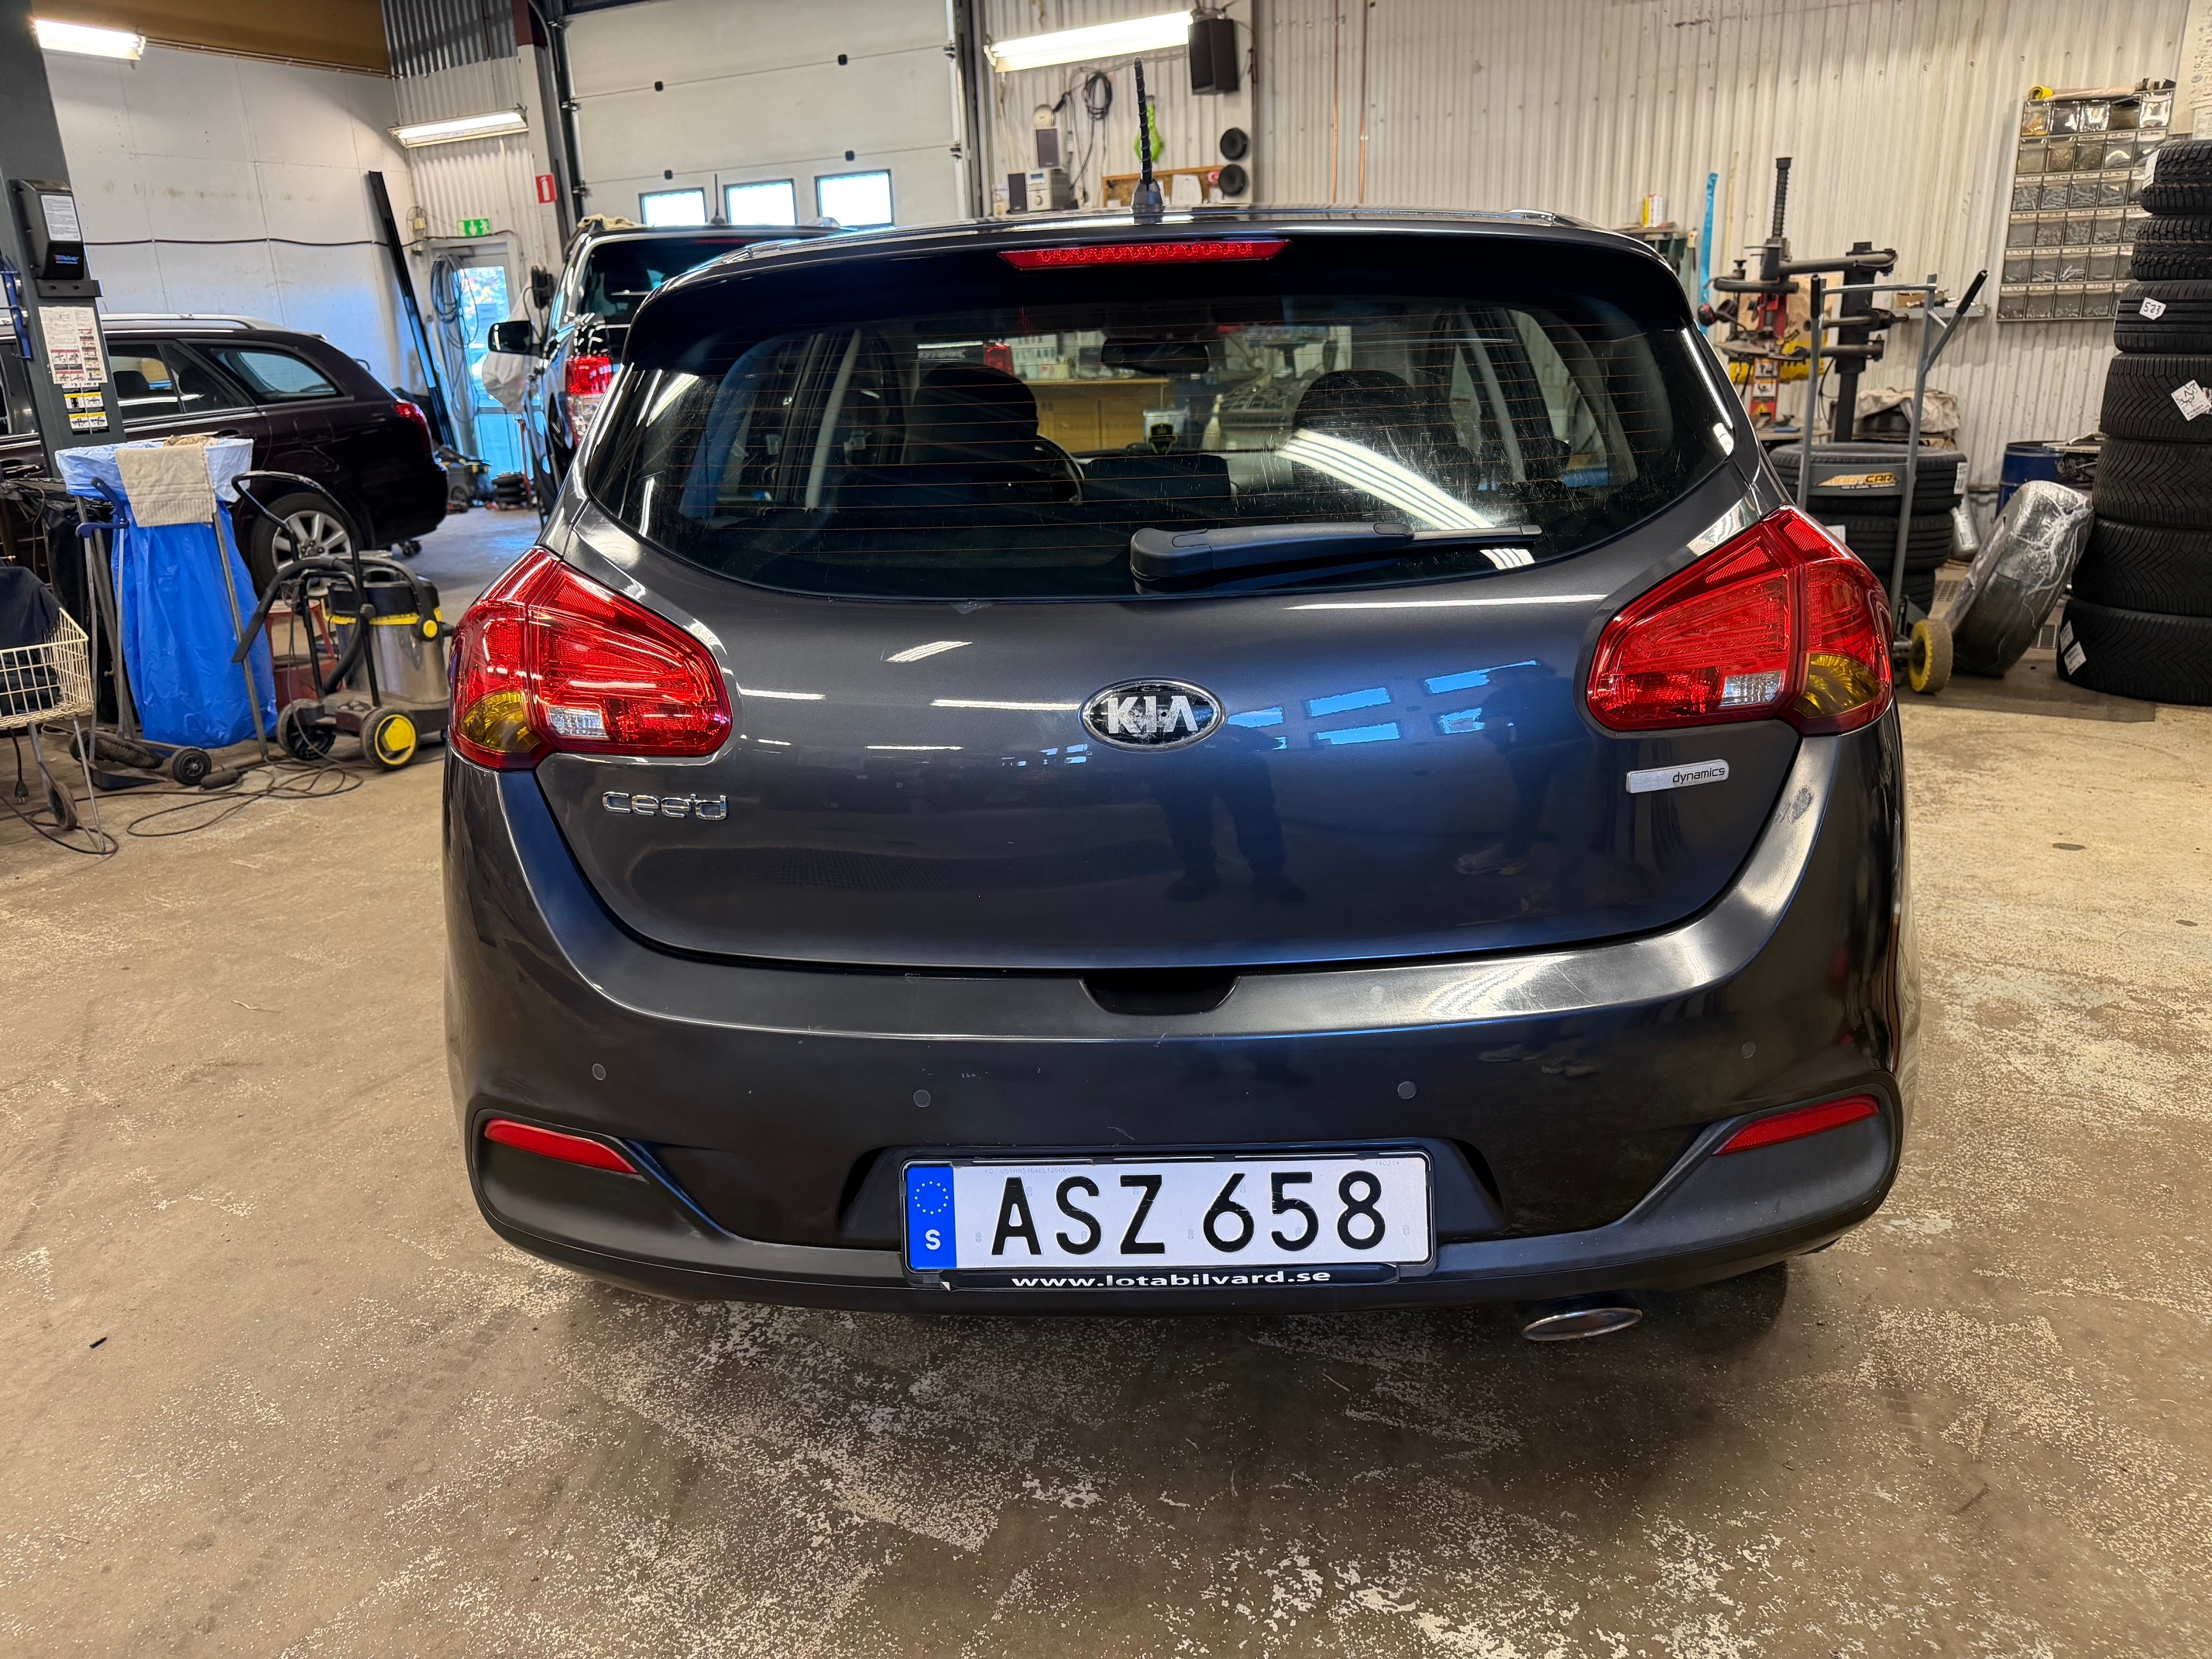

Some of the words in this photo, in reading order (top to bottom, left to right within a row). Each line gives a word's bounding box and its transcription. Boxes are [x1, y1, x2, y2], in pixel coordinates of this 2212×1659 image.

[2143, 301, 2162, 315] 523
[1107, 696, 1199, 734] KIA
[1673, 768, 1726, 784] dynamics
[602, 791, 729, 821] cee'd
[991, 1173, 1166, 1255] ASZ
[1202, 1170, 1386, 1253] 658
[925, 1228, 942, 1250] S
[1012, 1270, 1331, 1287] www.lotabilvard.se
